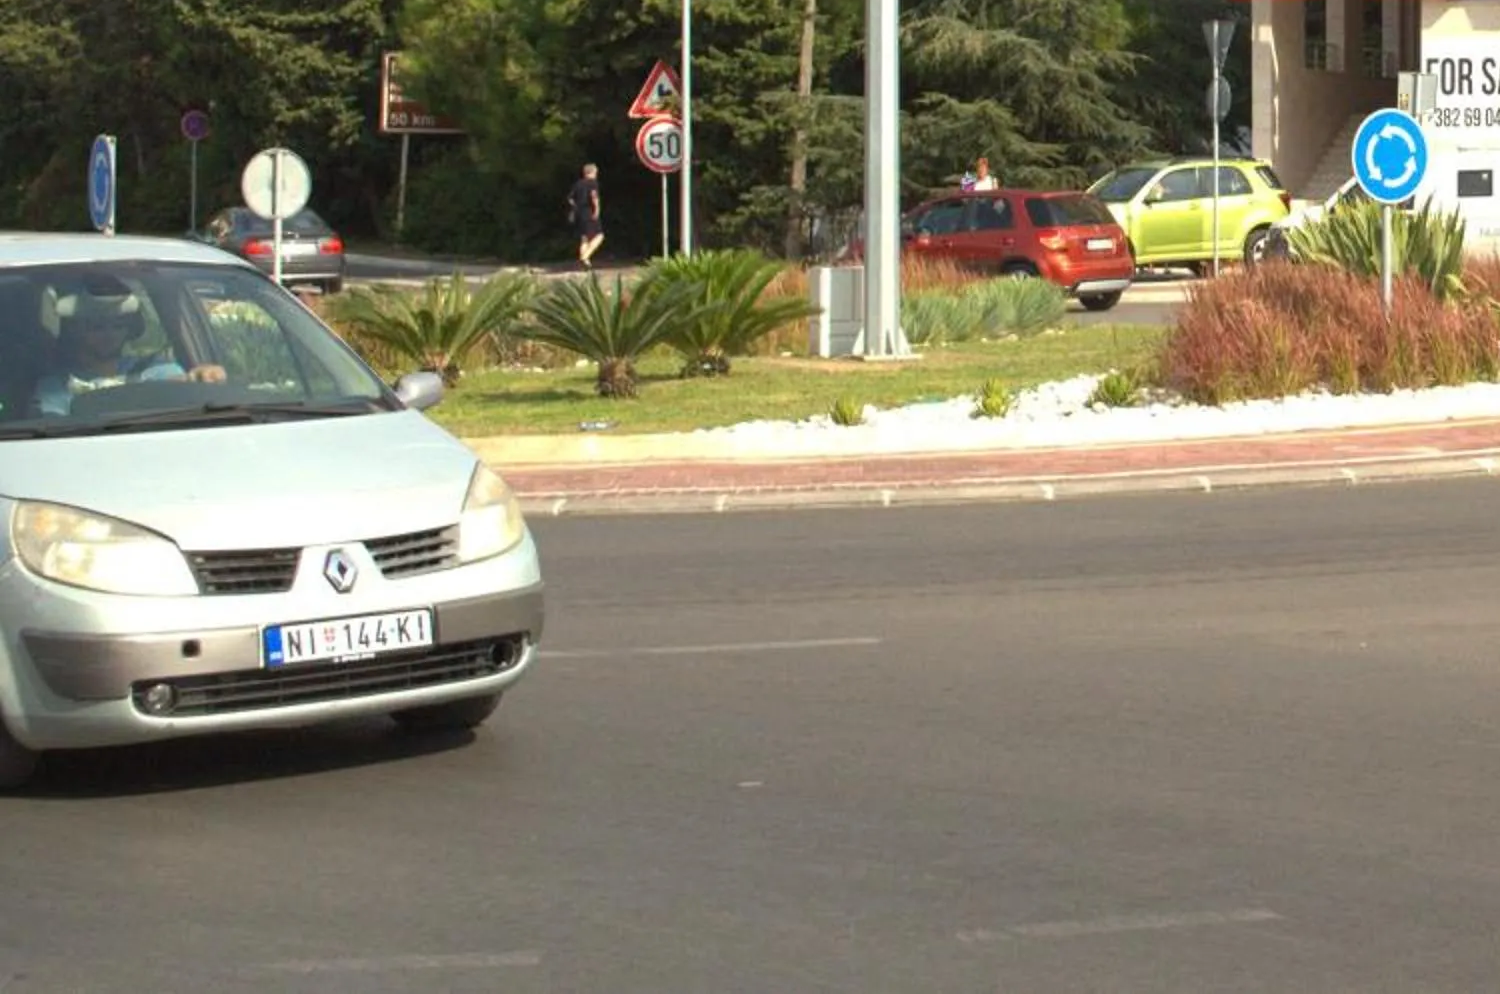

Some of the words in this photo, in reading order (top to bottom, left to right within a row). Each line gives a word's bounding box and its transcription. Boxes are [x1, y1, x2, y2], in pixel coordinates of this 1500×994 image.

[1463, 106, 1482, 127] 69
[649, 131, 680, 159] 50
[287, 628, 316, 657] NI
